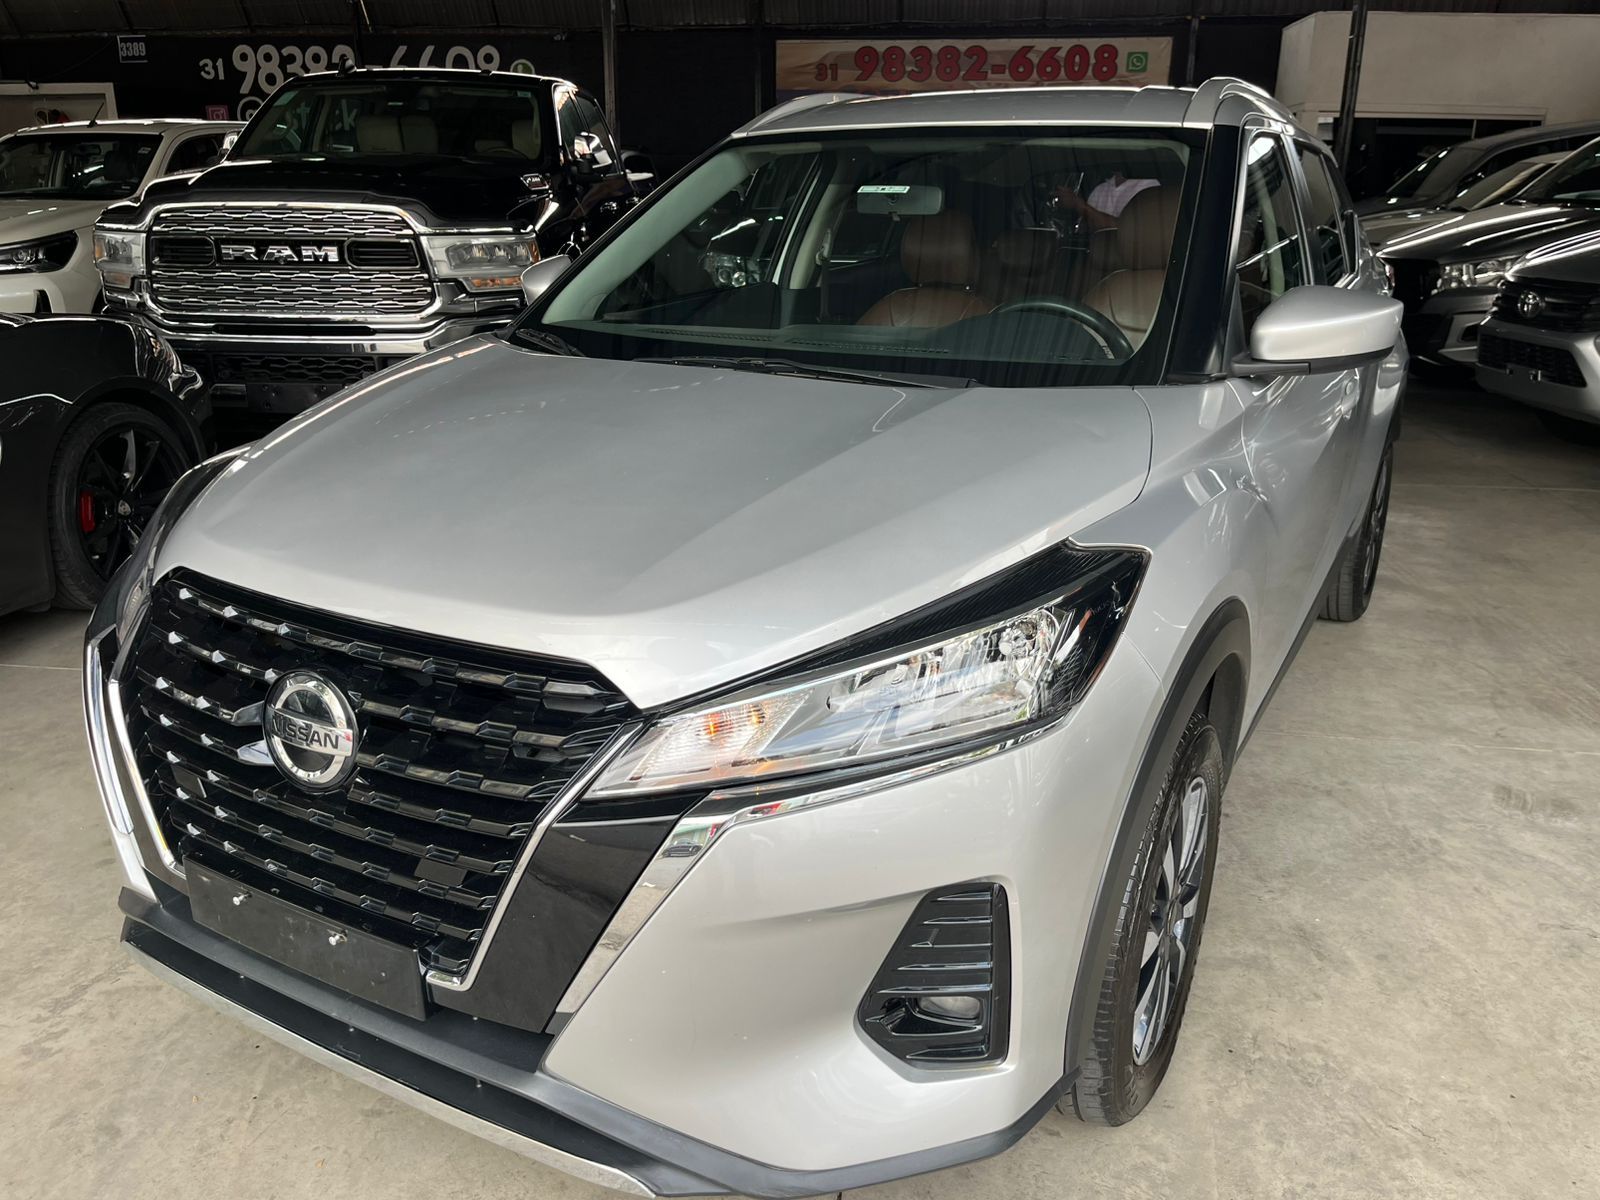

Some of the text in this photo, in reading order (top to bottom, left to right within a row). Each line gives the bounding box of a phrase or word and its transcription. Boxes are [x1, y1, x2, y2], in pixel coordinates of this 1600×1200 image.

[120, 42, 146, 57] 3389
[199, 58, 225, 80] 31
[814, 44, 1118, 82] 31 98382-6608
[220, 245, 339, 262] RAM
[272, 711, 339, 749] NISSAN
